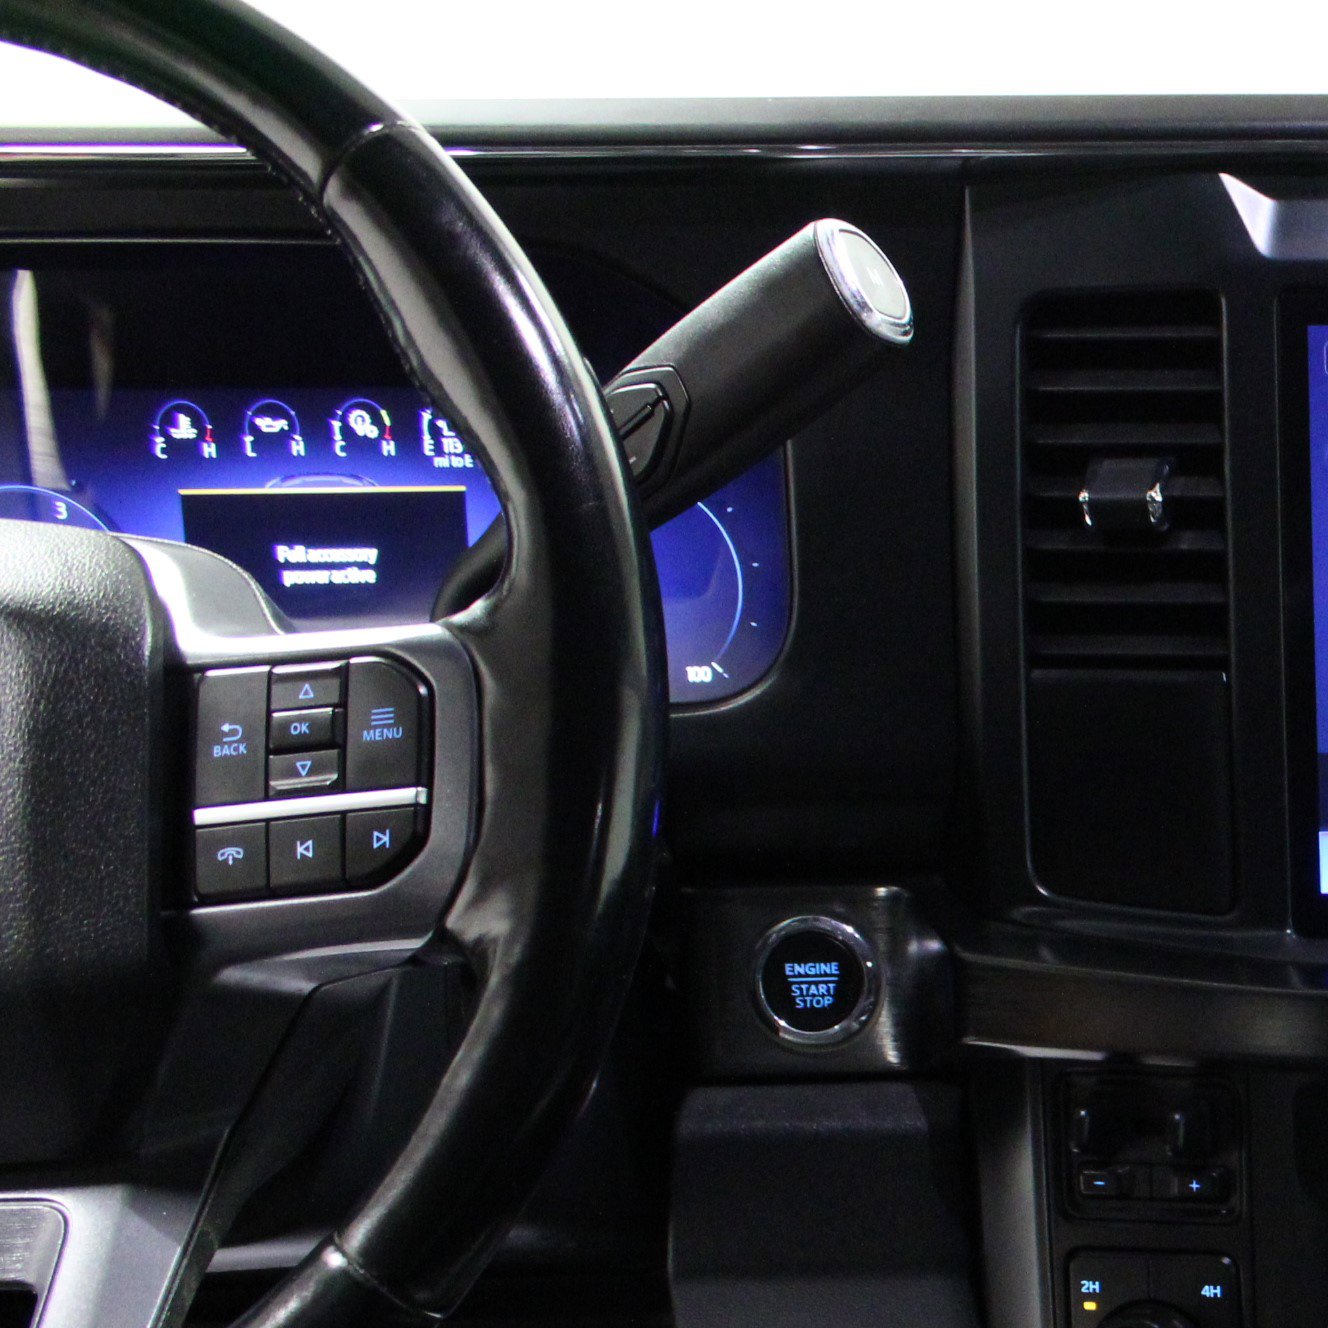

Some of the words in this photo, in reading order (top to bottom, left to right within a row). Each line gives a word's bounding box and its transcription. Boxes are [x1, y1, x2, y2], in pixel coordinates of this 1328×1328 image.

[54, 501, 69, 520] 3
[686, 665, 713, 684] 100
[290, 721, 310, 735] OK
[362, 726, 403, 742] MENU
[213, 742, 247, 757] BACK
[785, 961, 840, 977] ENGINE
[791, 982, 837, 998] START
[795, 995, 834, 1010] STOP
[1080, 1280, 1100, 1295] 2H
[1200, 1284, 1222, 1299] 4H
